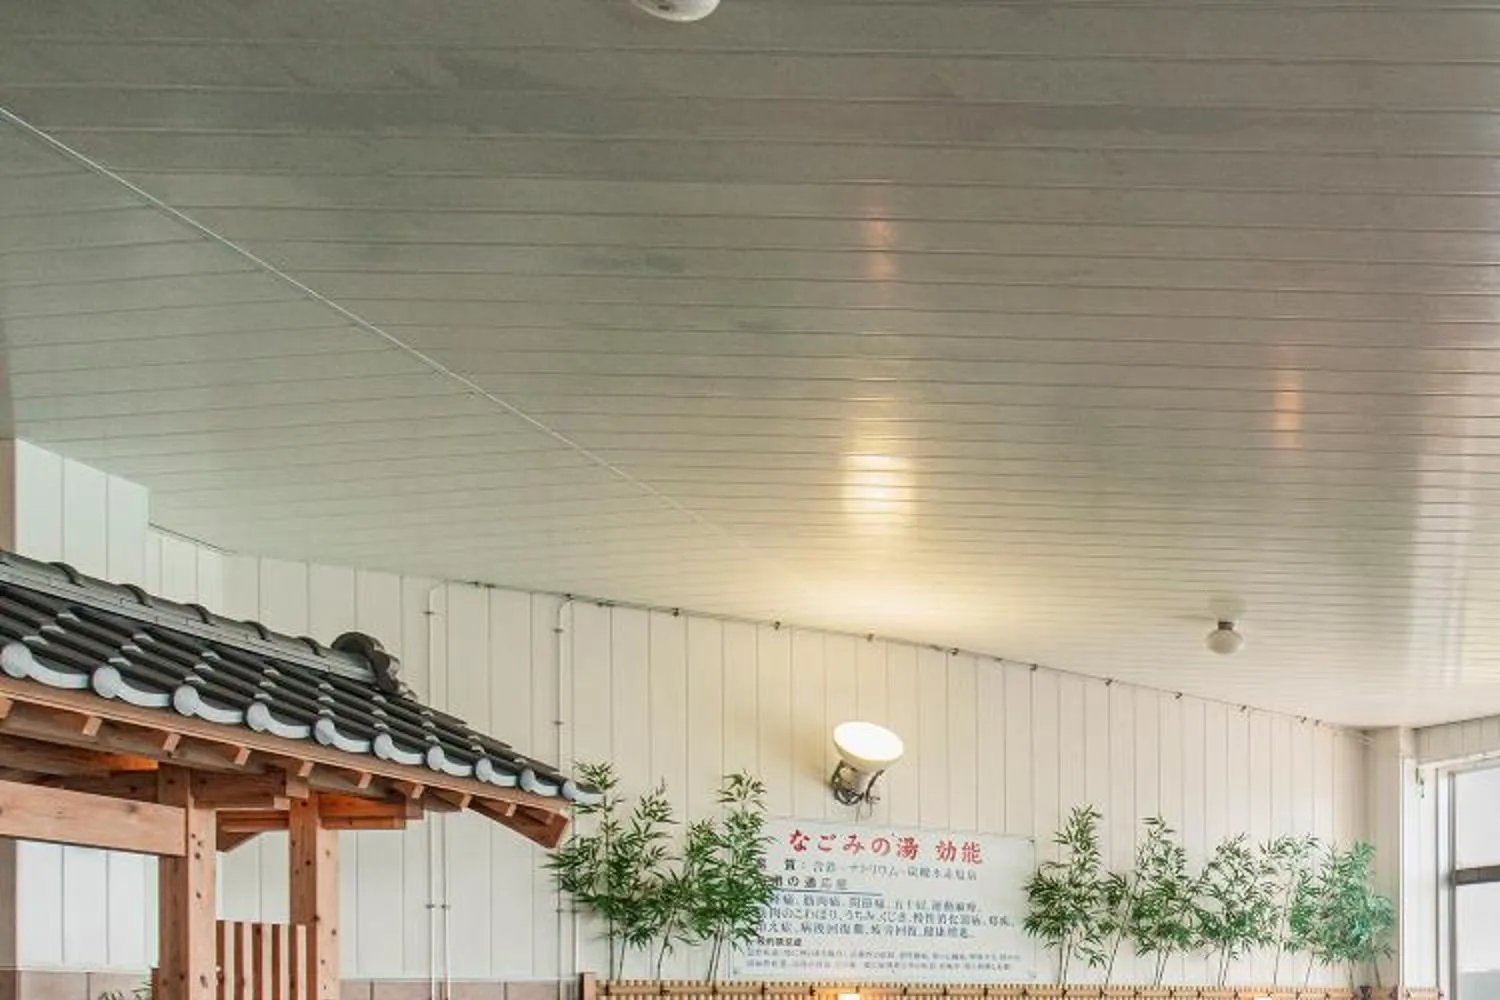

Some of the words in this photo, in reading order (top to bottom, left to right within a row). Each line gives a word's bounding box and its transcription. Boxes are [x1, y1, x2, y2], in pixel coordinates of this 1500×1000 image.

[789, 829, 919, 861] なごみの湯
[935, 839, 983, 865] 効能
